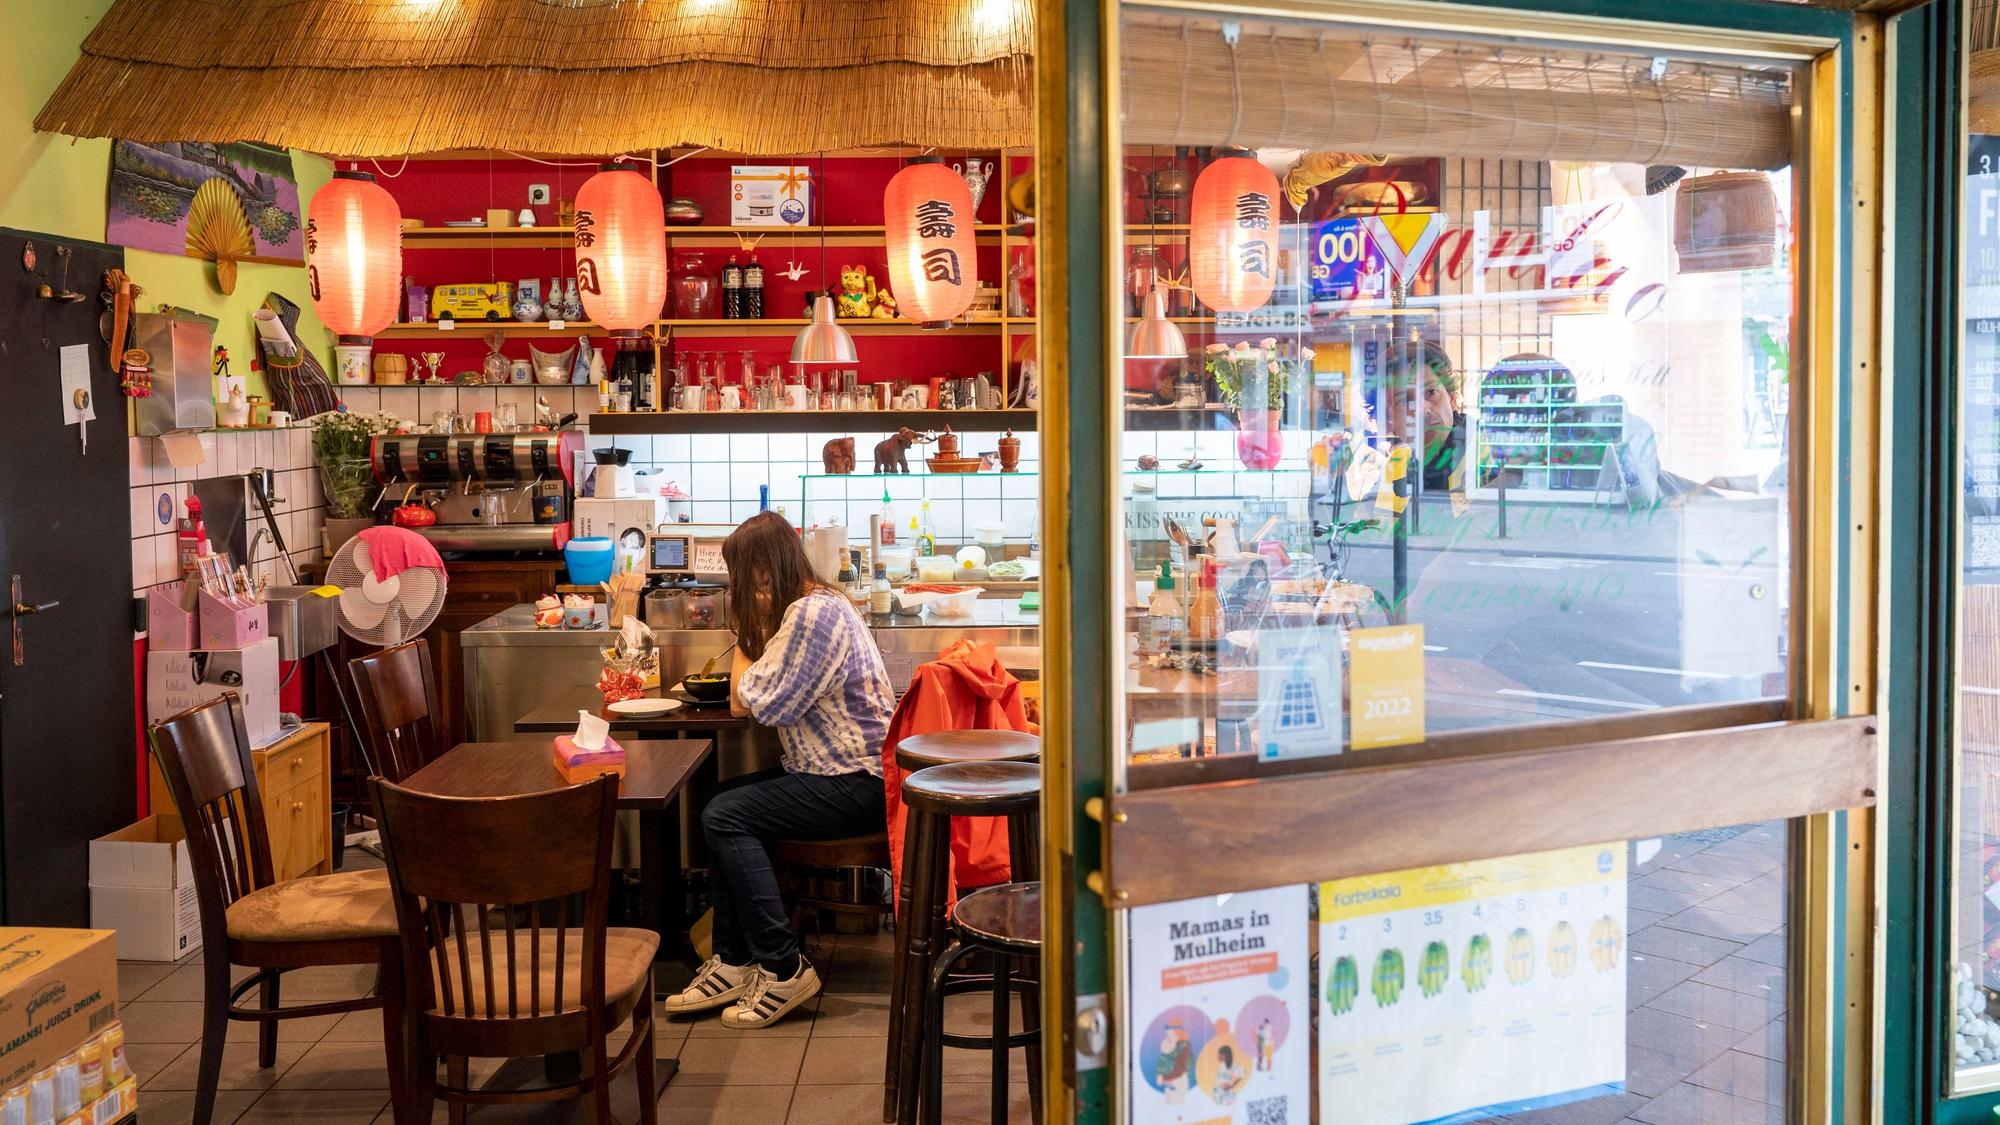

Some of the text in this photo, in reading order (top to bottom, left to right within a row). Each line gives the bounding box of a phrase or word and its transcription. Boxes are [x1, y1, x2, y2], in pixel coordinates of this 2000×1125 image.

[1363, 696, 1413, 720] 2022
[1169, 910, 1271, 940] Mamas in
[1338, 926, 1348, 941] 2
[1382, 917, 1392, 933] 3
[1472, 904, 1482, 918] 4
[1517, 898, 1526, 912] 5
[45, 1007, 73, 1031] JUICE
[74, 990, 102, 1013] DRINK
